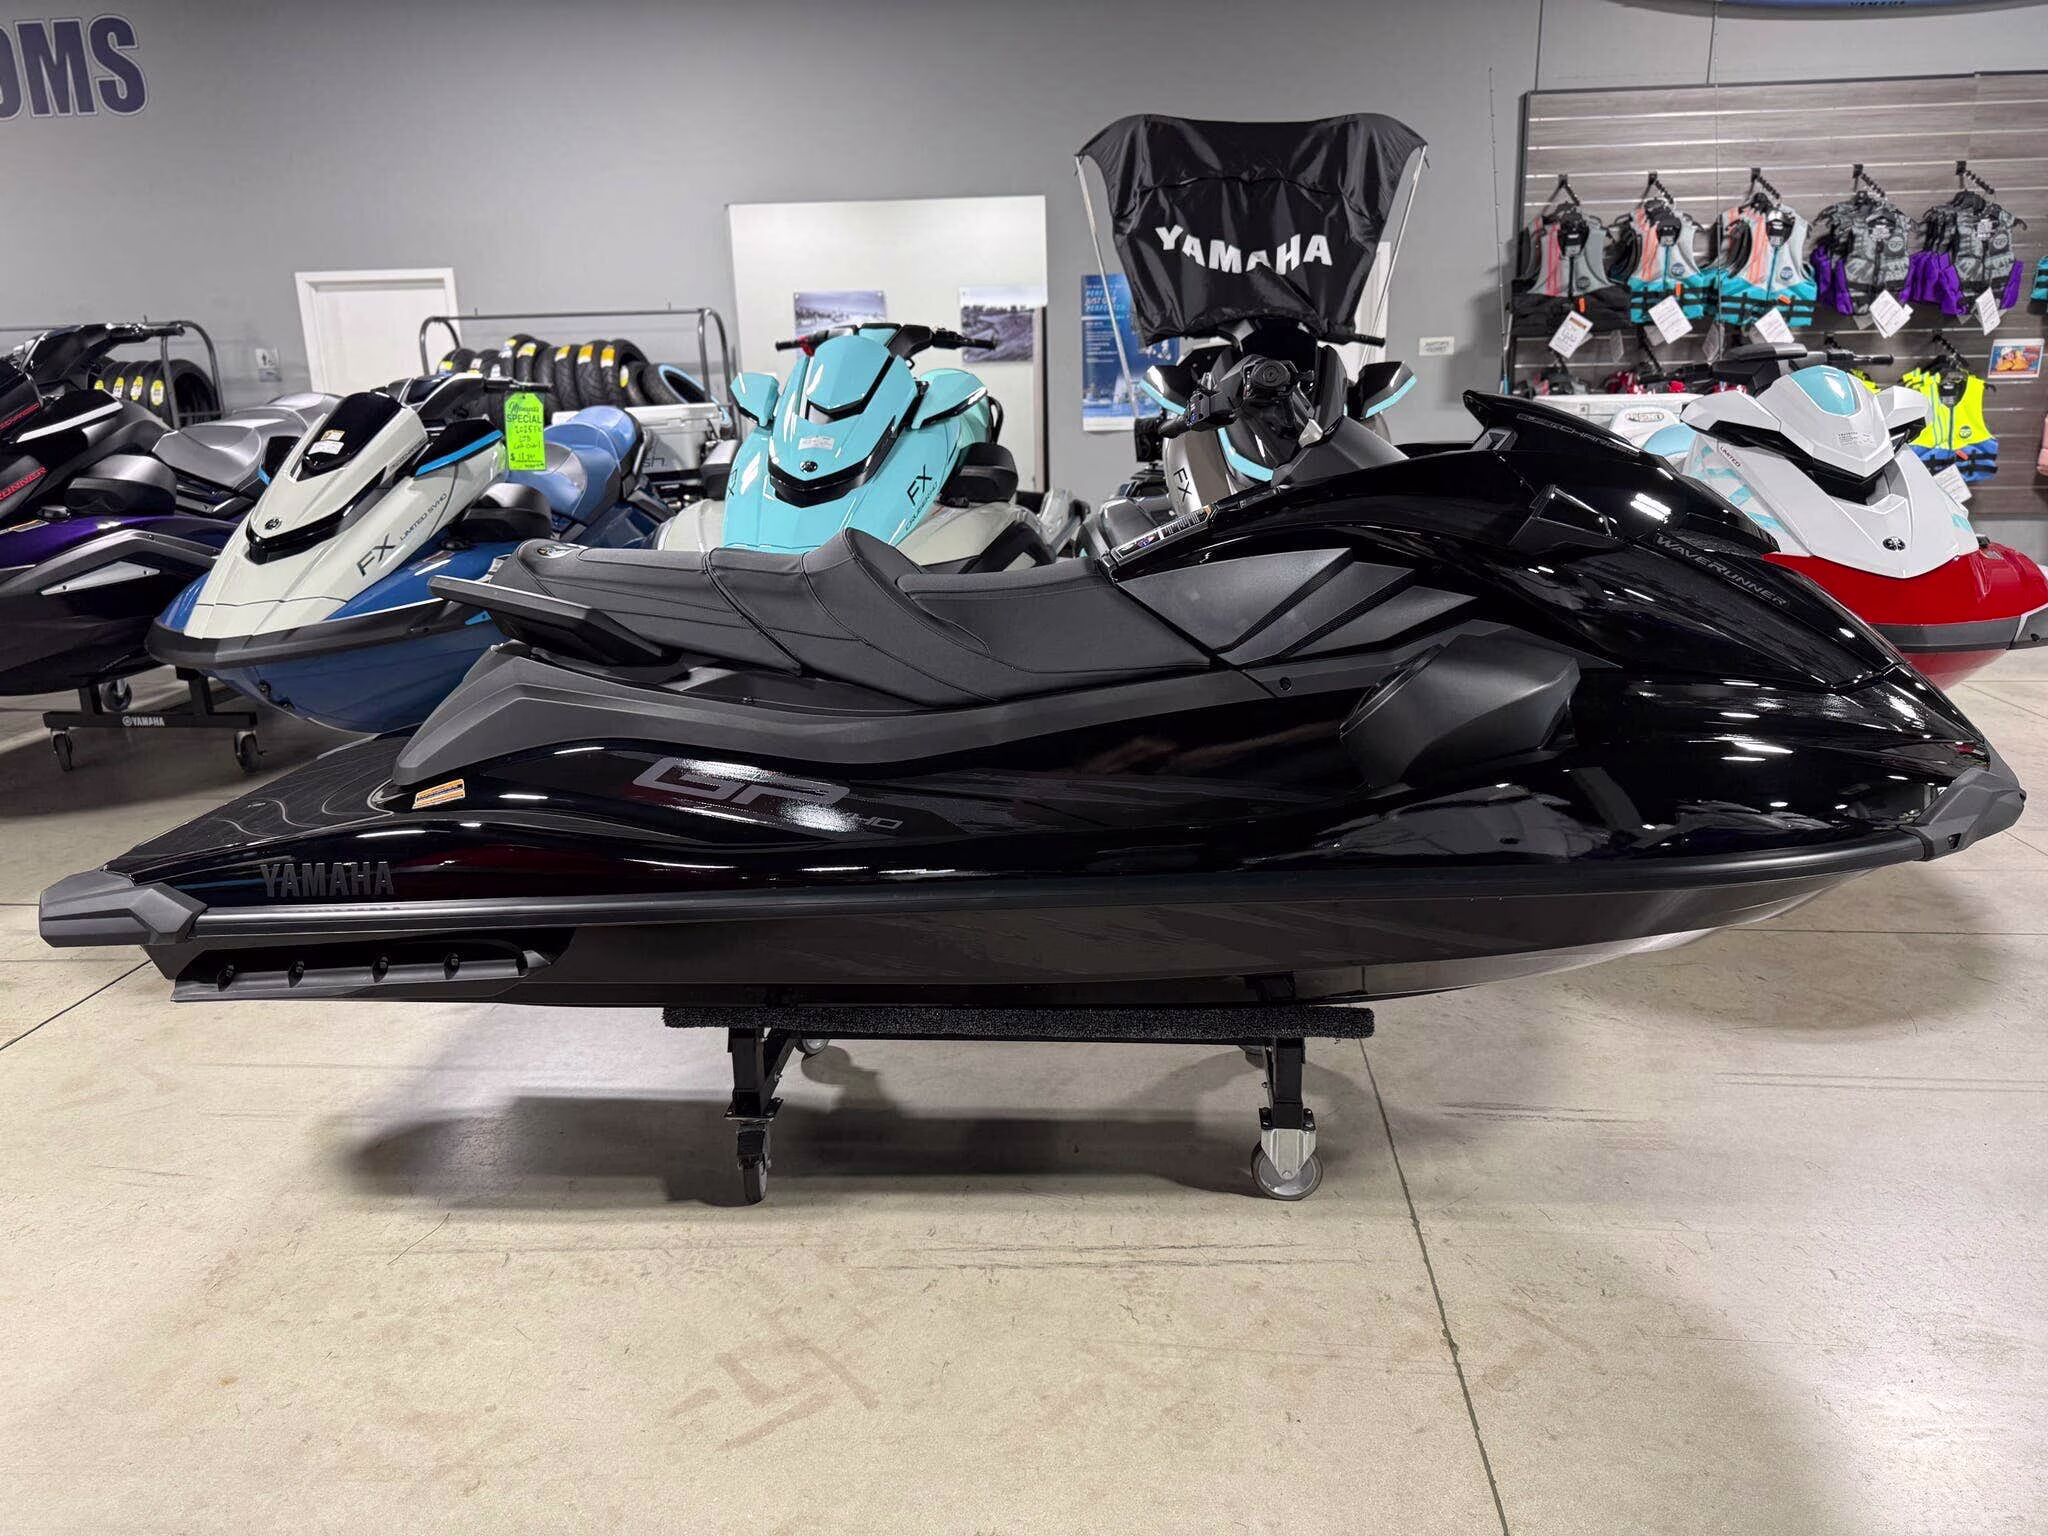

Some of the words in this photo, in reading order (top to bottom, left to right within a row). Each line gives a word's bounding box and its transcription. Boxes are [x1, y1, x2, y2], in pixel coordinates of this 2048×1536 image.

[1155, 224, 1333, 276] YAMAHA
[506, 414, 542, 423] SPECIAL
[906, 463, 933, 507] FX
[1173, 467, 1193, 503] FX
[400, 513, 429, 541] LIMITED
[356, 532, 397, 577] FX
[1656, 535, 1788, 606] WAVERUNNER
[131, 716, 166, 727] YAMAHA
[260, 861, 395, 898] YAMAHA
